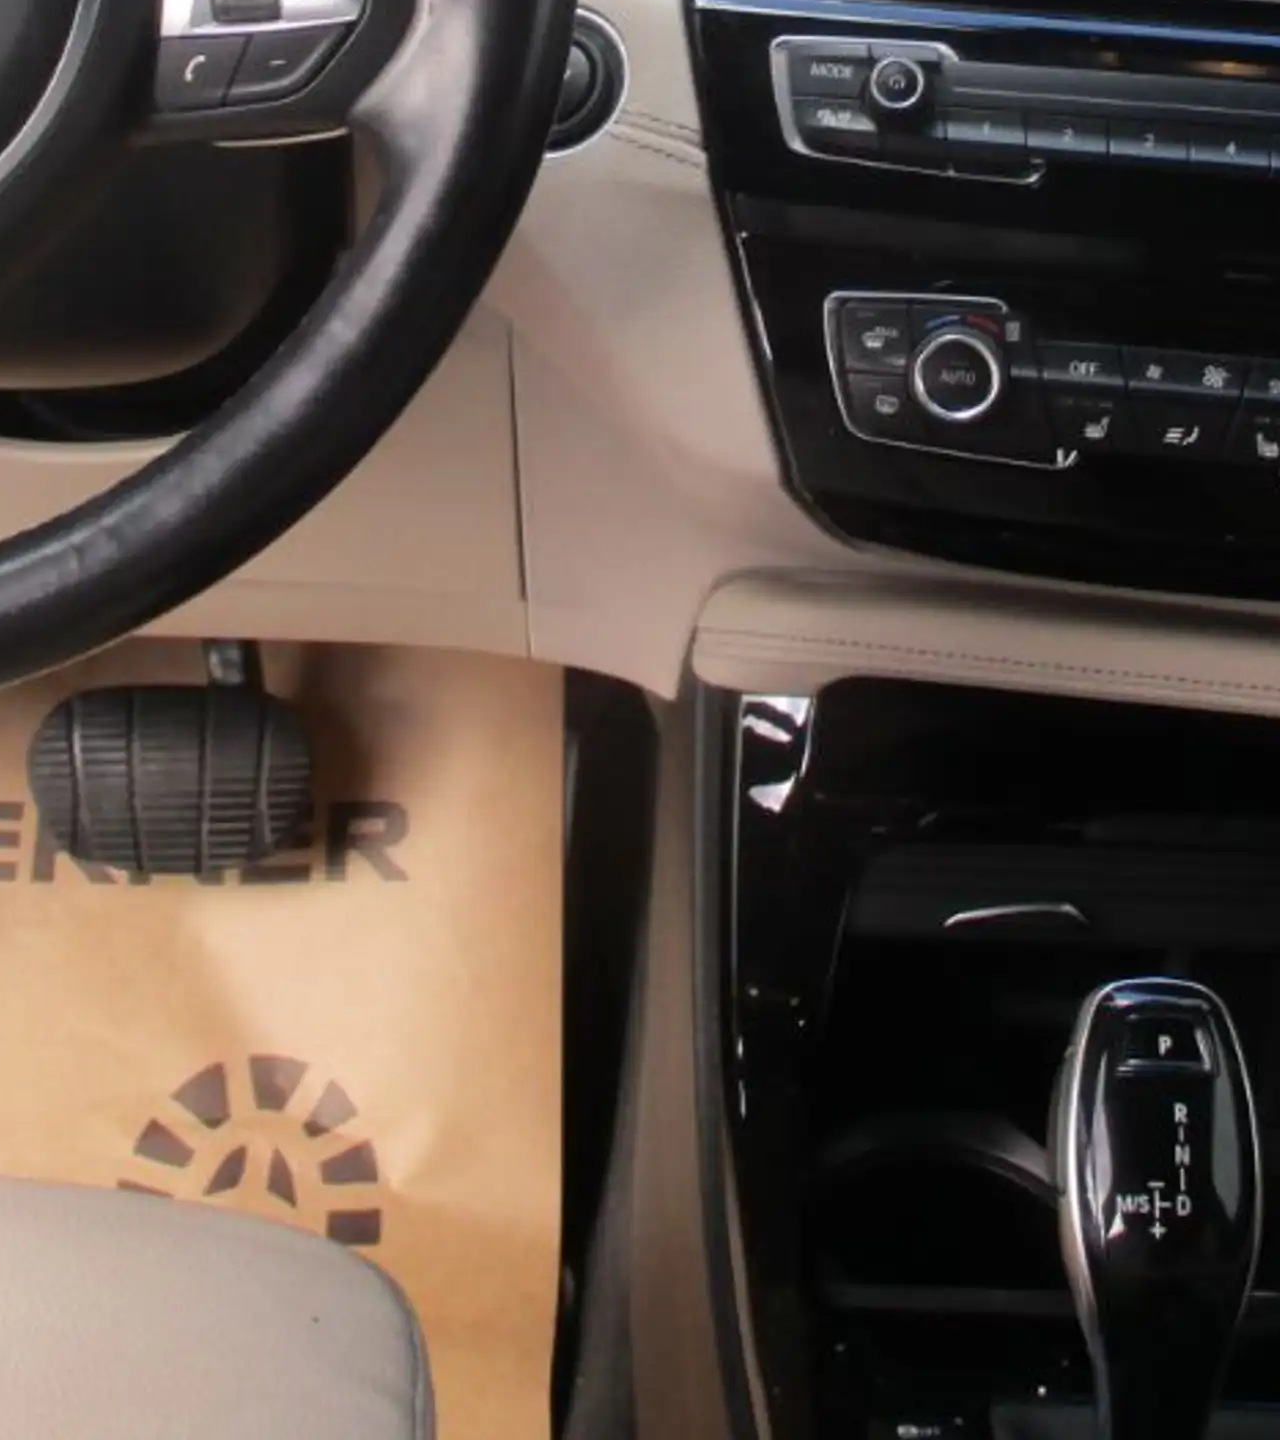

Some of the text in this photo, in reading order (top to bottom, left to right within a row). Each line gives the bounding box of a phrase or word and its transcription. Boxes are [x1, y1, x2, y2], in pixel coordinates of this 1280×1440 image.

[1069, 361, 1101, 379] OFF
[1158, 1034, 1173, 1057] P
[1173, 1102, 1188, 1125] R
[1174, 1143, 1190, 1167] N
[1175, 1194, 1192, 1217] D
